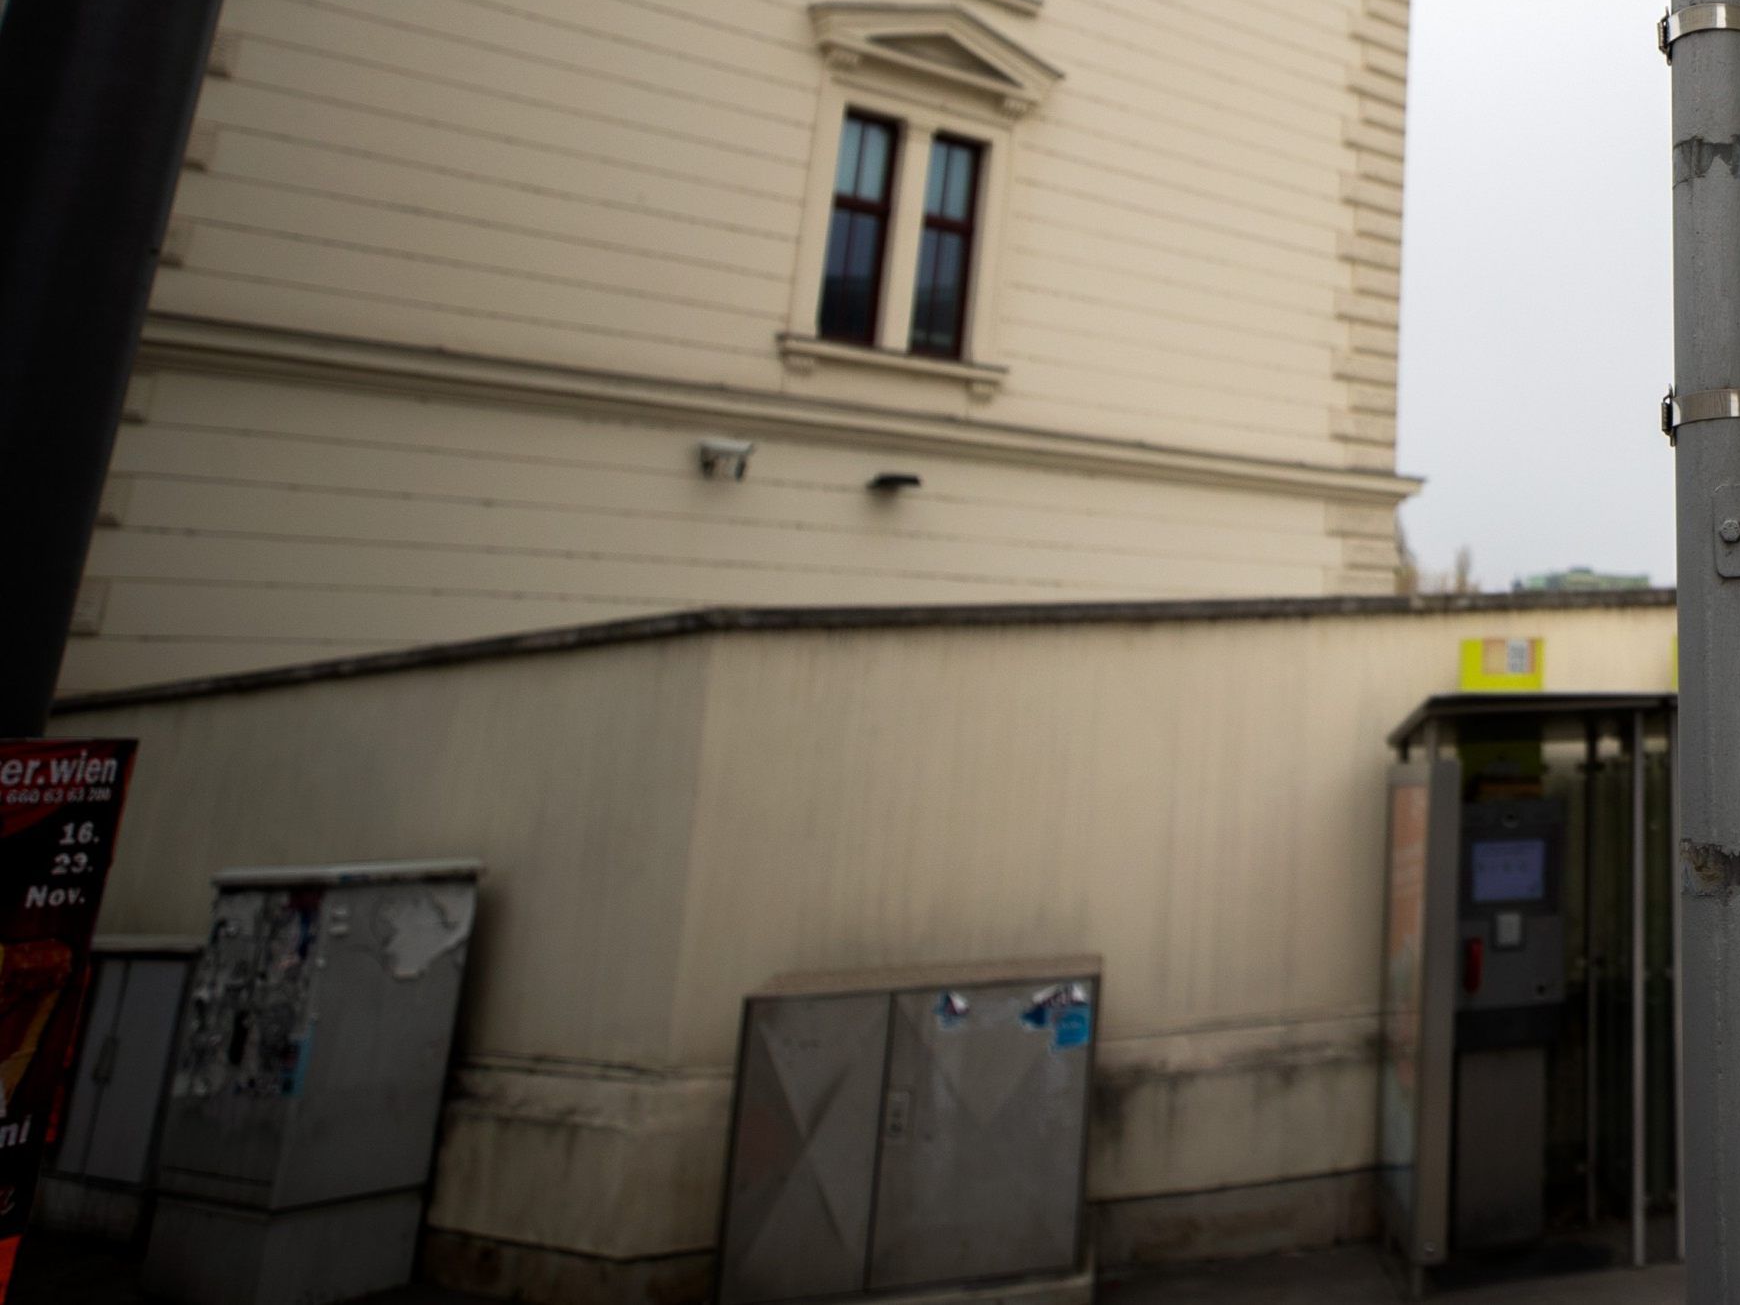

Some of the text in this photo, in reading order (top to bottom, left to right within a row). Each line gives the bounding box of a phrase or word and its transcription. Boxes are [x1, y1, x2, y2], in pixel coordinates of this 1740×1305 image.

[0, 749, 118, 785] er.wien
[59, 821, 100, 844] 16.
[51, 852, 93, 875] 23.
[24, 885, 85, 909] Nov.
